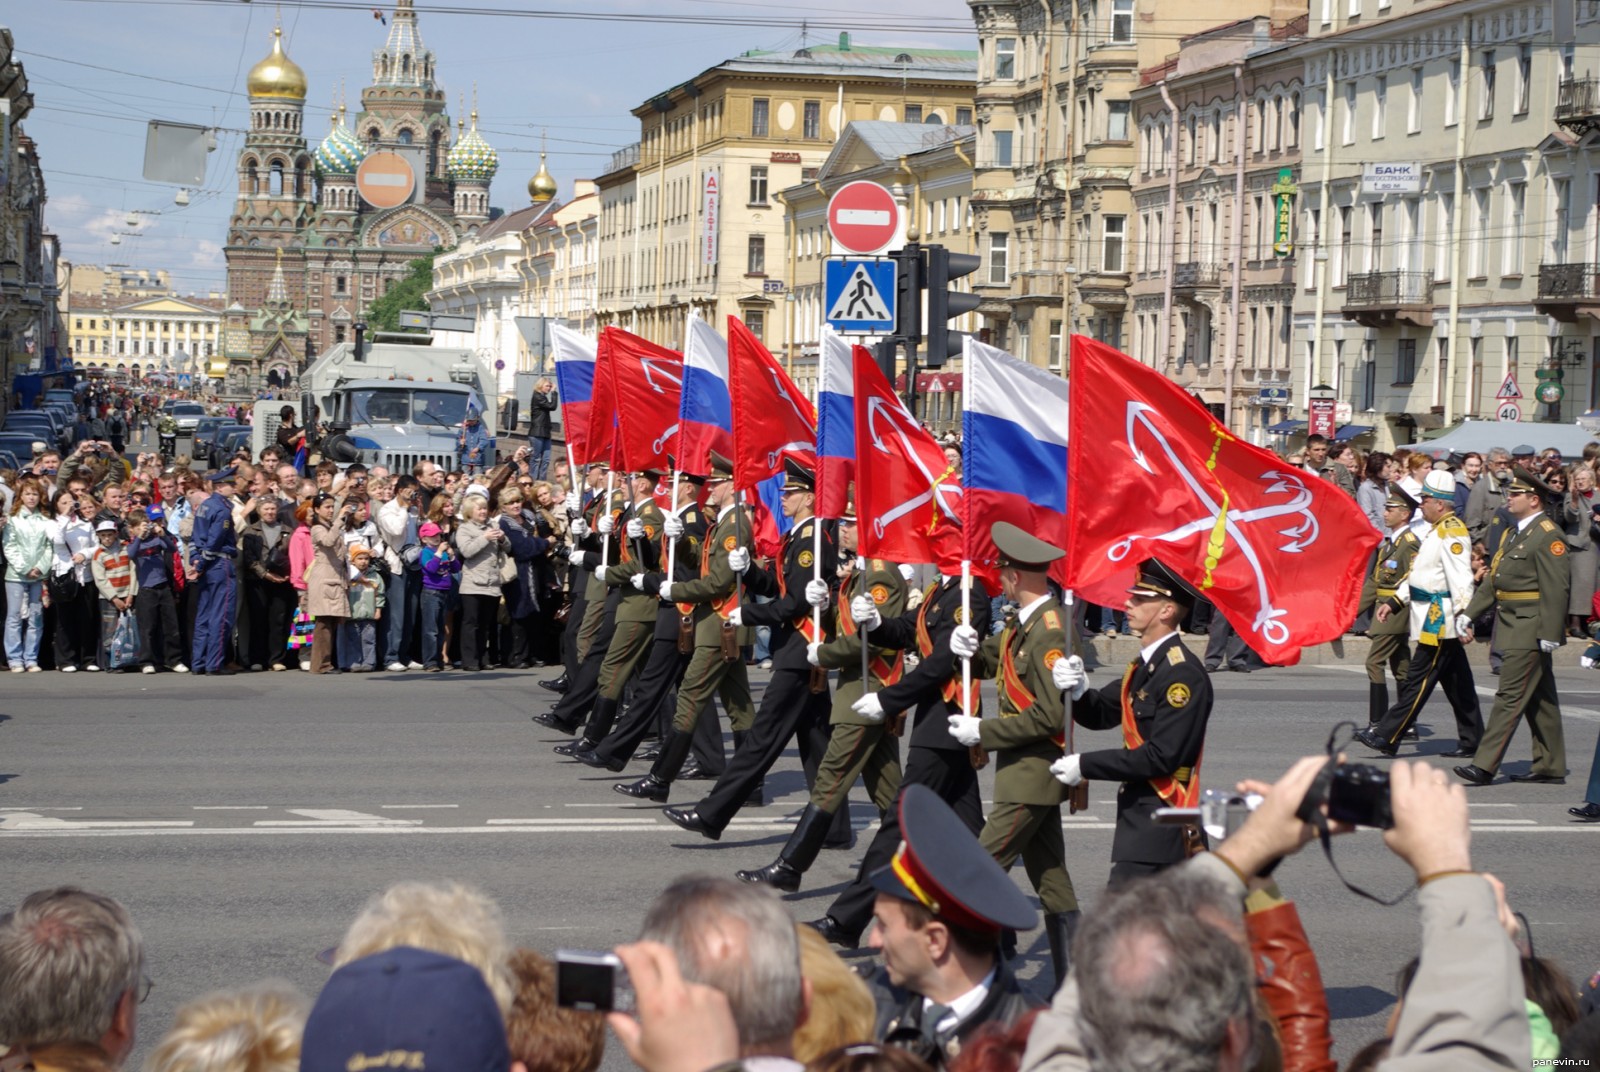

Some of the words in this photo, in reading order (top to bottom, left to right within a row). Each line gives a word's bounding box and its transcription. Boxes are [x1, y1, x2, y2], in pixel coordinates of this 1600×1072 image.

[1375, 166, 1411, 175] БАНК
[1279, 193, 1290, 243] ЧАЙКА
[1500, 408, 1518, 420] 40
